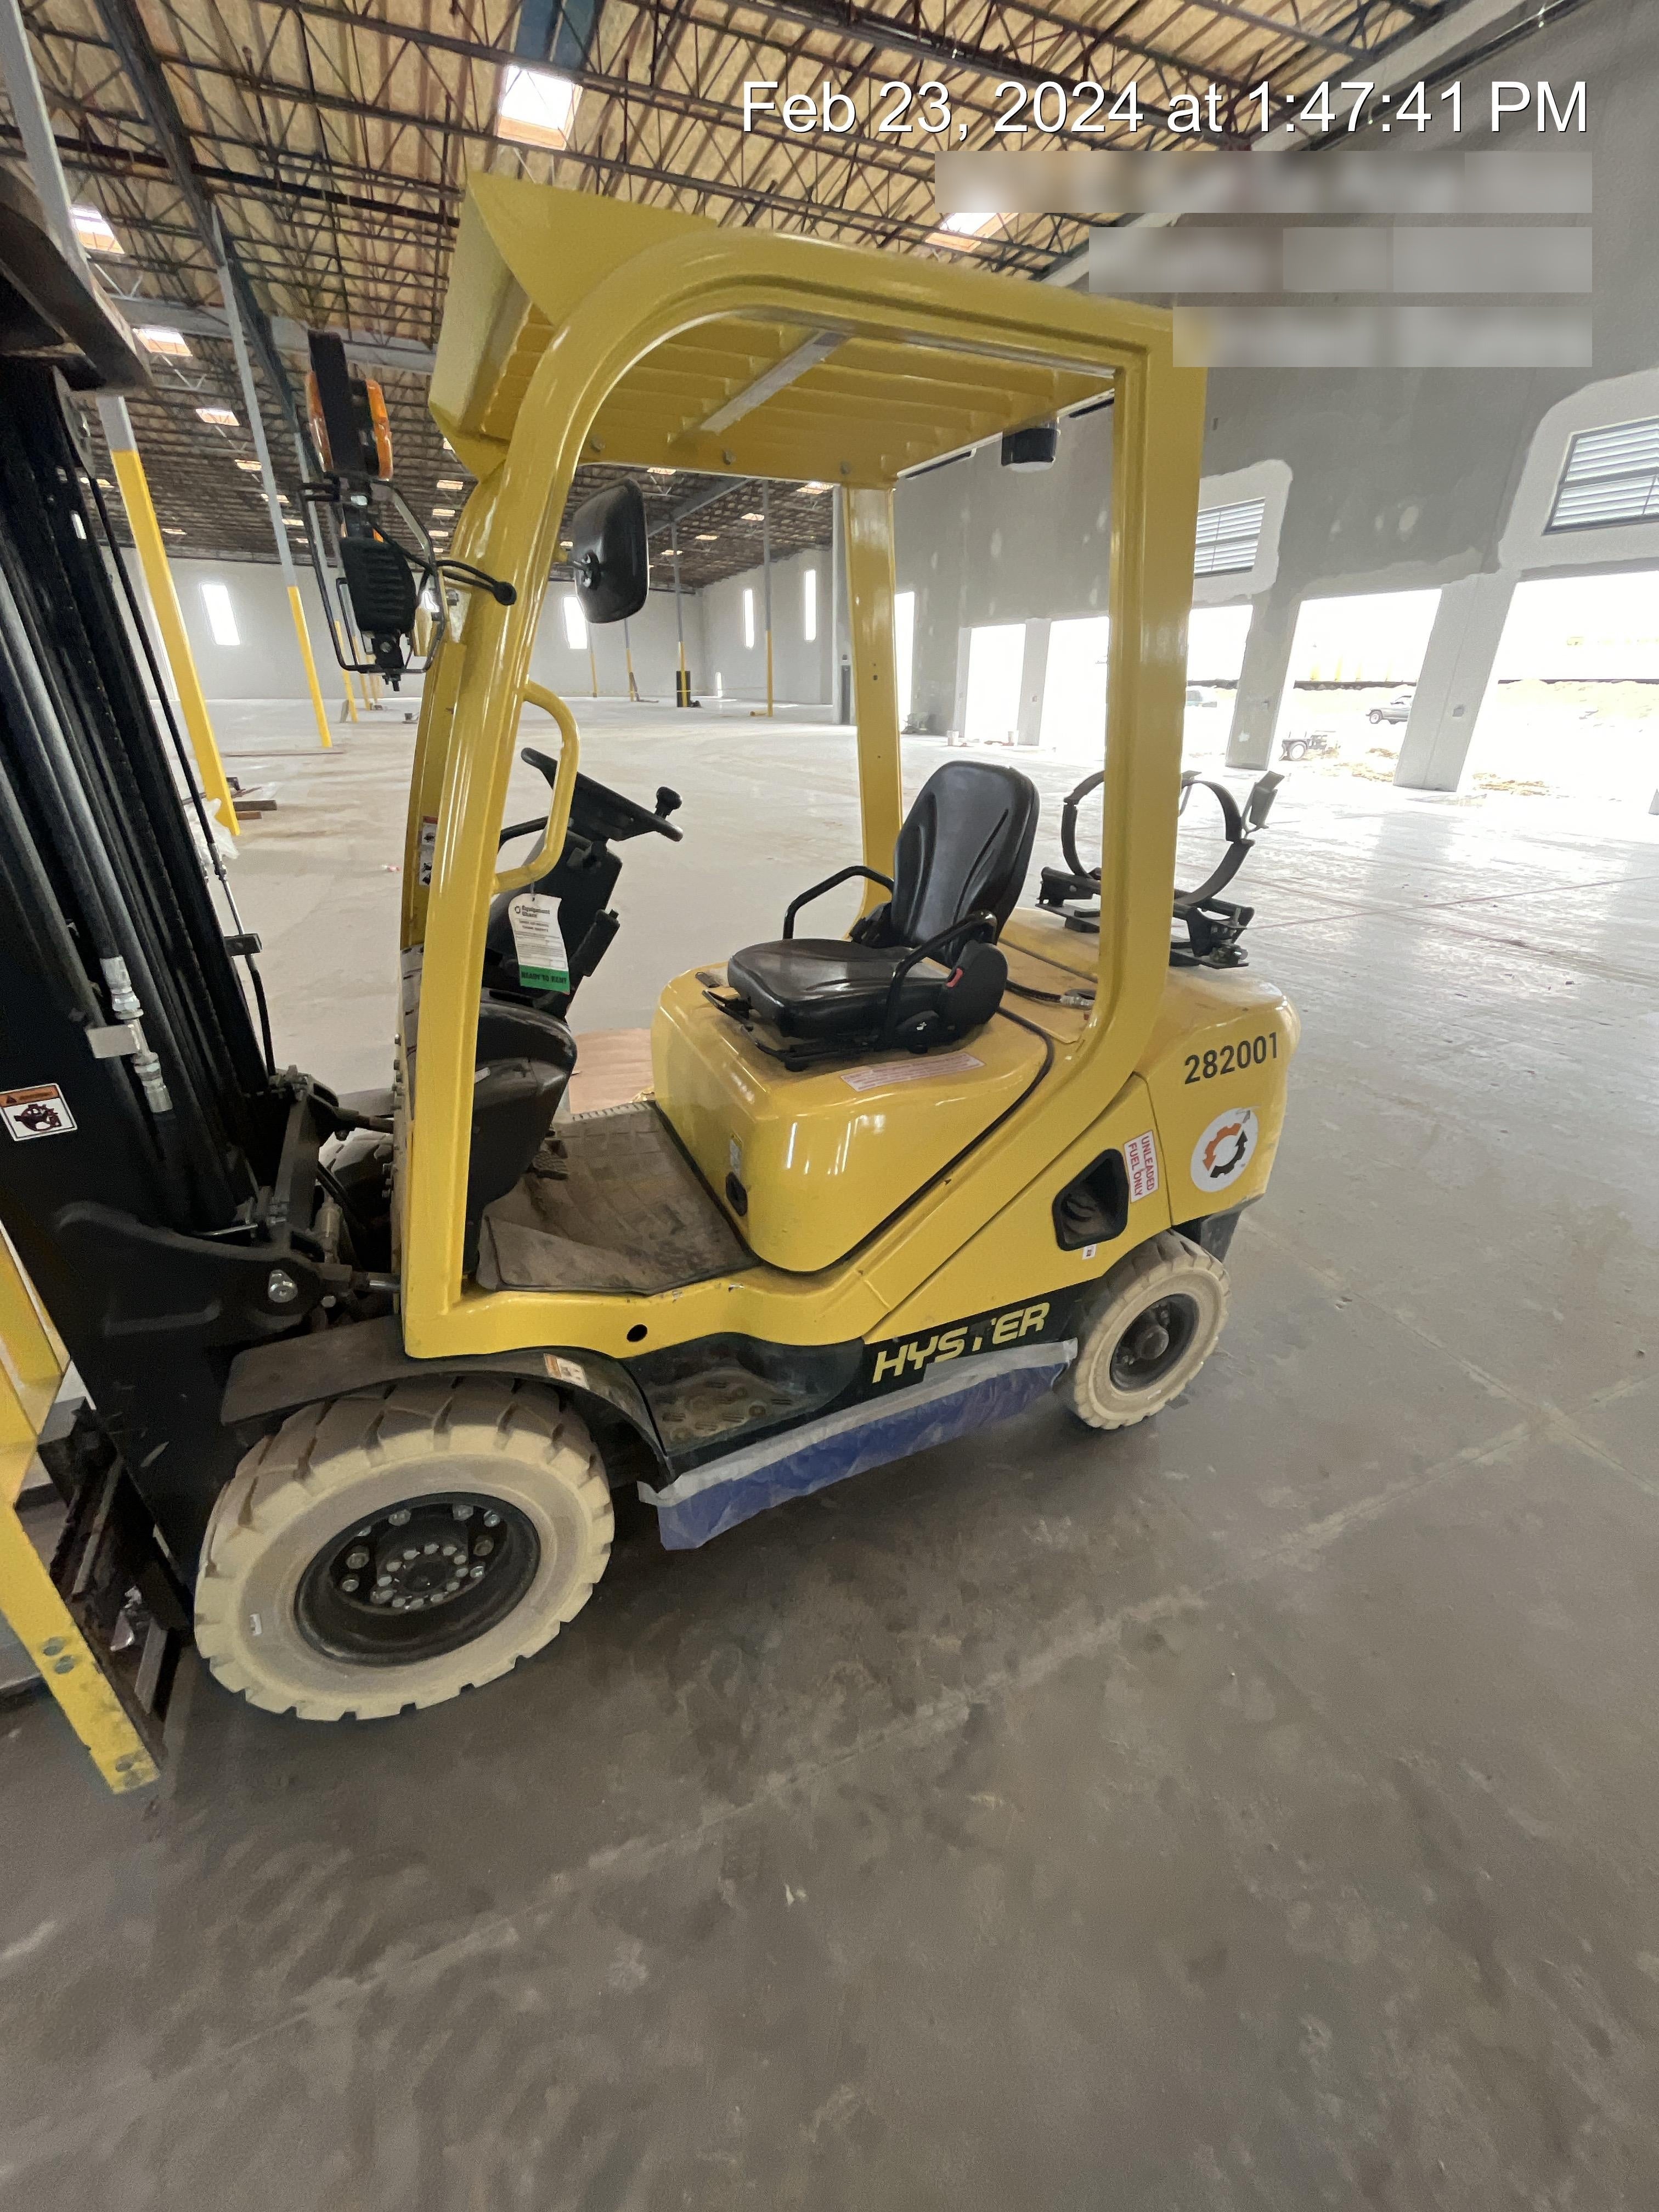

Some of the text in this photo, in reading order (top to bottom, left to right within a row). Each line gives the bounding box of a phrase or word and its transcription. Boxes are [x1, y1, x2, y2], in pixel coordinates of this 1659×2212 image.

[521, 972, 540, 980] READY
[1184, 1031, 1278, 1085] 282001
[1128, 1142, 1143, 1196] FUEL ONLY
[1142, 1135, 1155, 1191] UNLEADED
